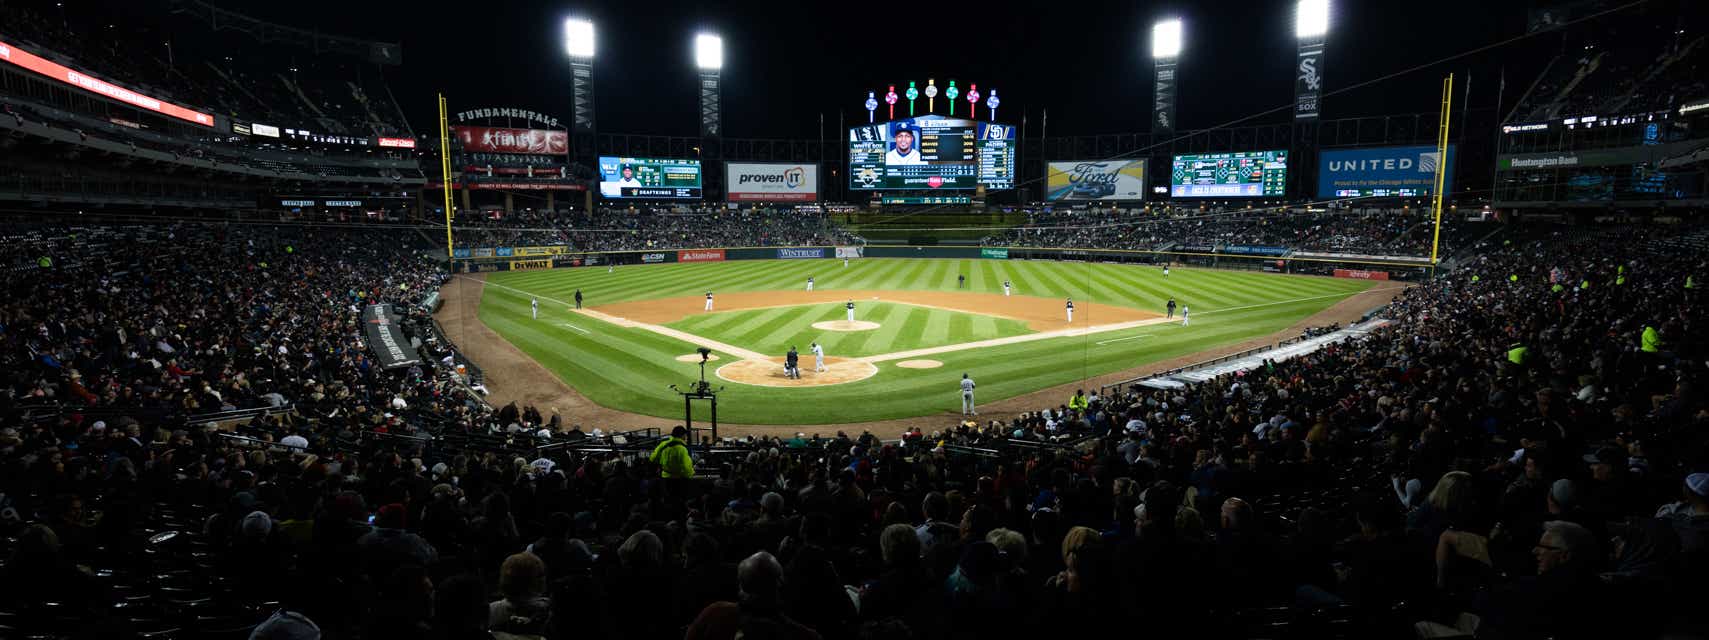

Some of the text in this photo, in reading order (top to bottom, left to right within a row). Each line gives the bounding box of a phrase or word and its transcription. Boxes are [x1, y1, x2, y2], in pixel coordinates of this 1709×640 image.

[458, 108, 558, 127] FUNDAMENTALS
[1329, 158, 1412, 171] UNITED
[1511, 157, 1557, 168] Huntington
[739, 173, 800, 184] proven IT
[1069, 163, 1121, 184] Ford
[780, 249, 821, 258] WINTRUST
